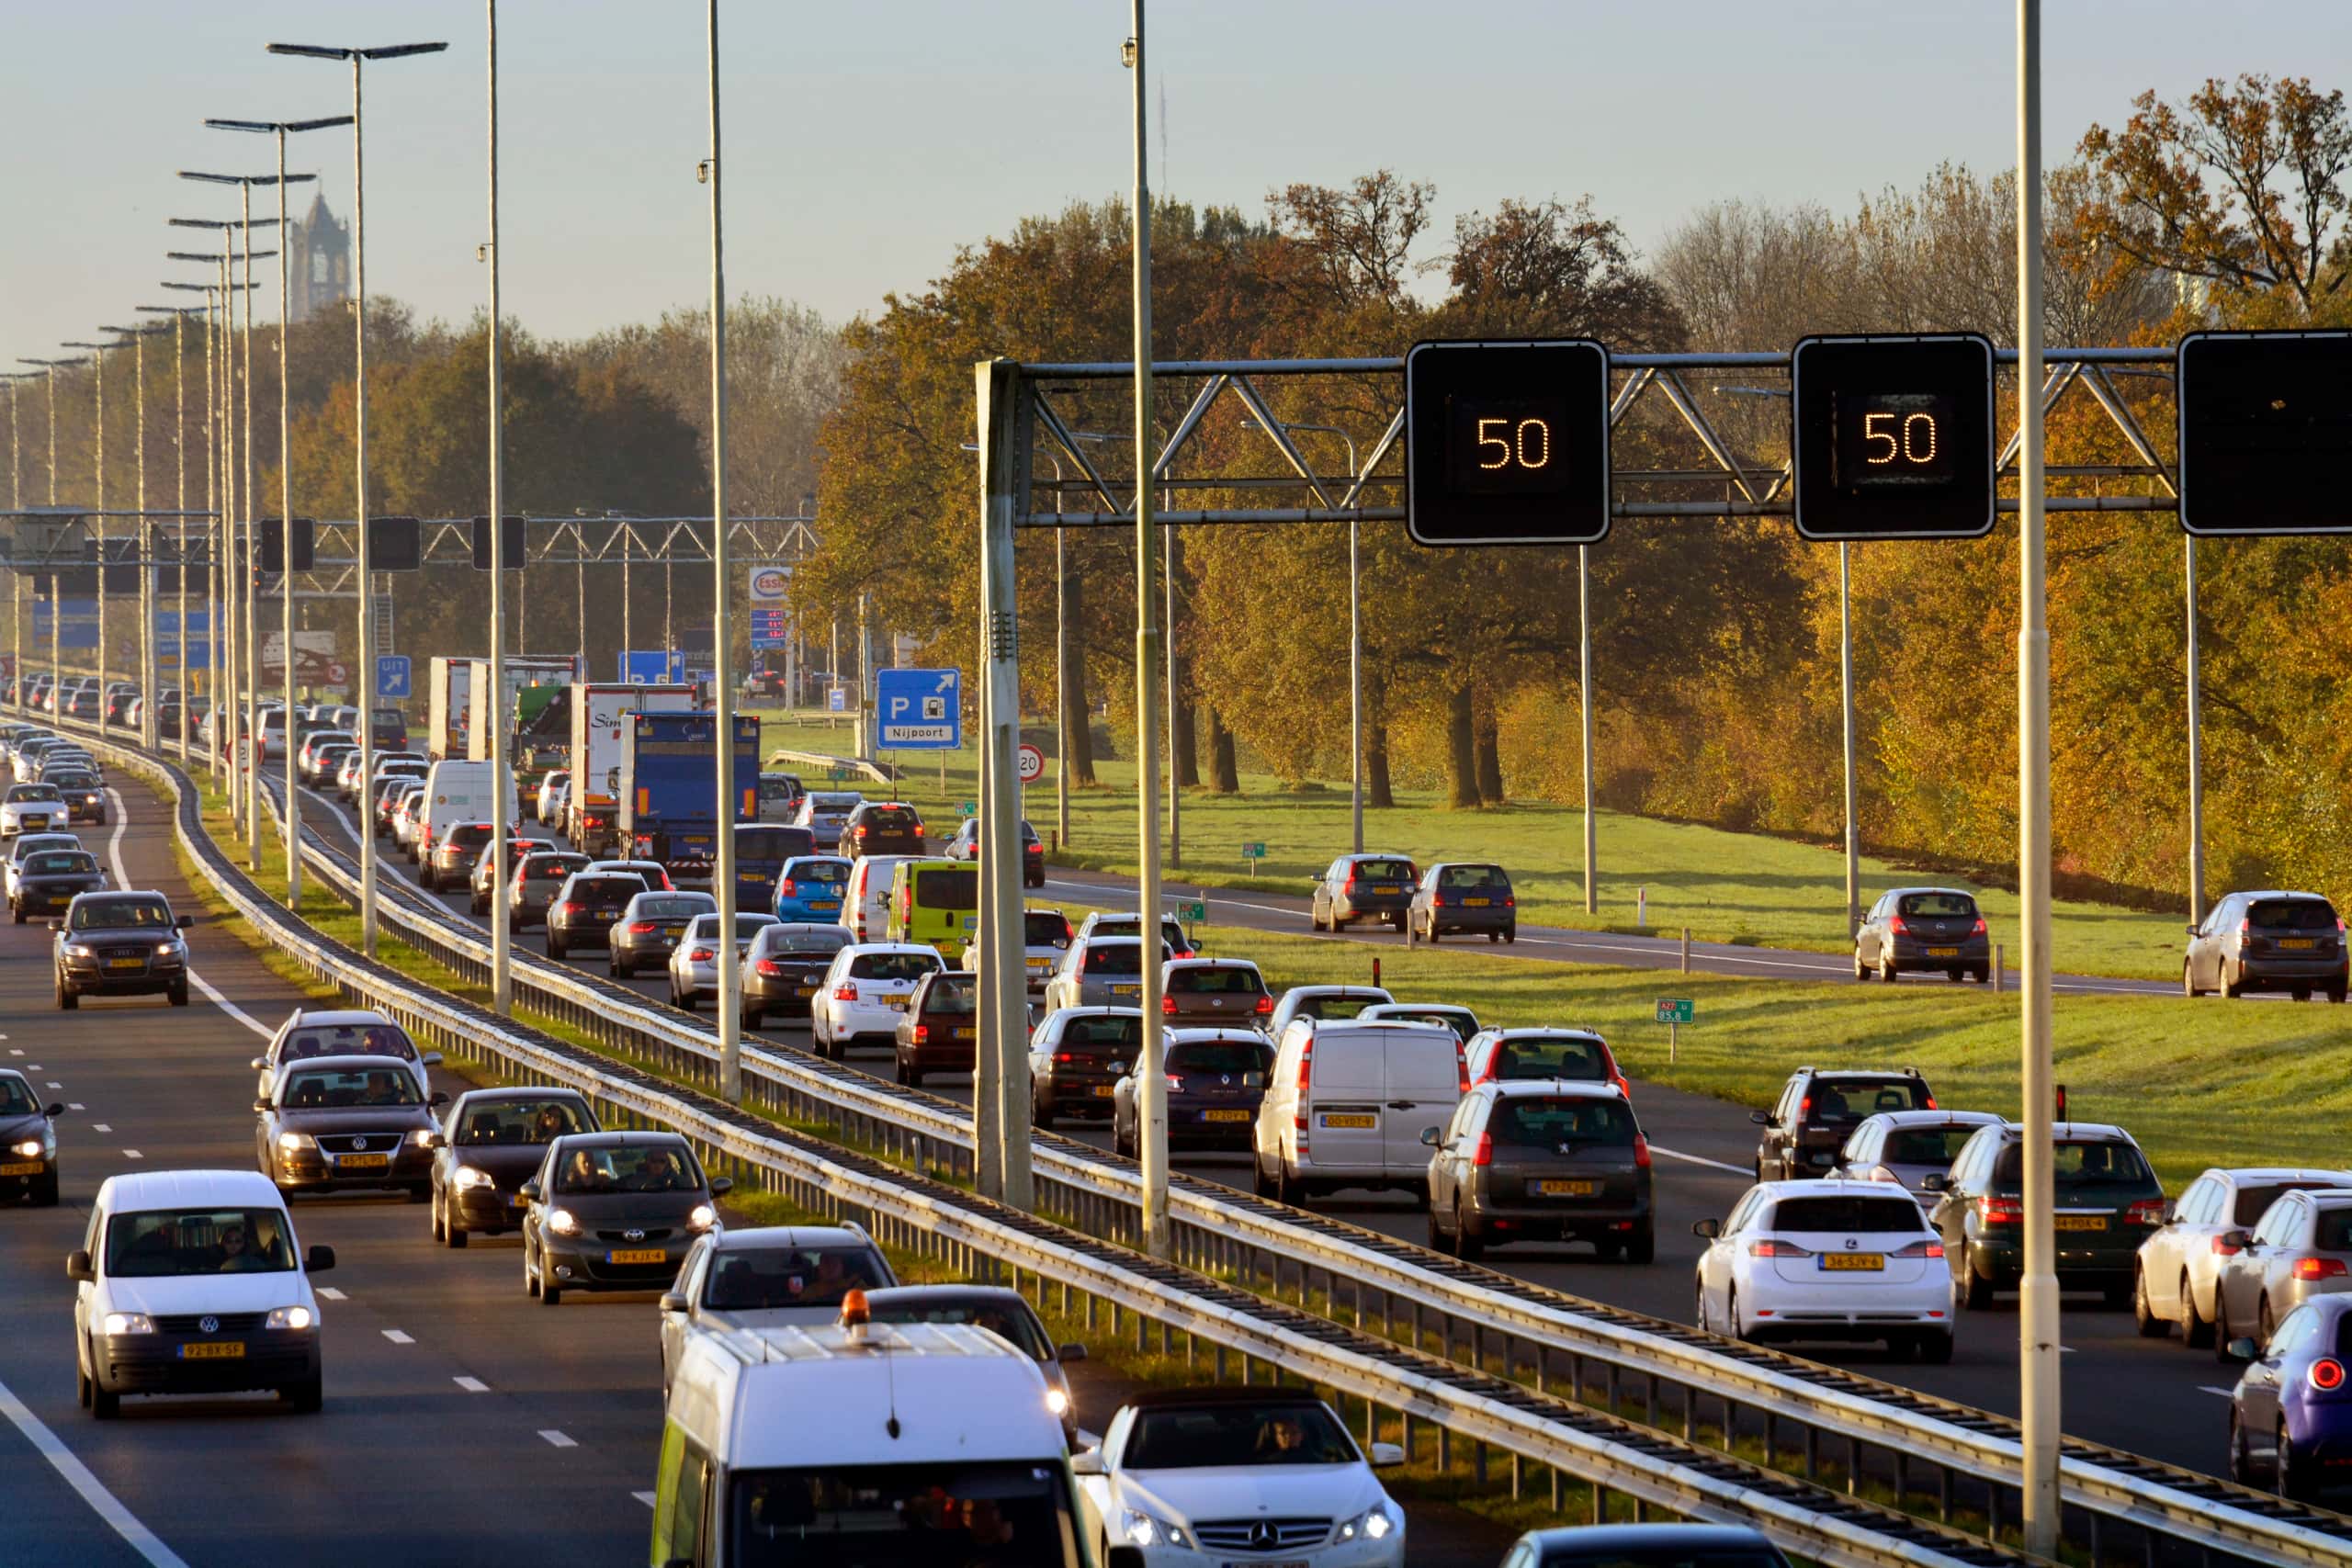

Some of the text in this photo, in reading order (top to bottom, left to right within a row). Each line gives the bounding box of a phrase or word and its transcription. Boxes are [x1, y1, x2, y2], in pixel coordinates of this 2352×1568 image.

[1478, 419, 1548, 468] 50
[1866, 413, 1936, 463] 50
[891, 696, 910, 719] P
[892, 727, 944, 739] Nijpoort
